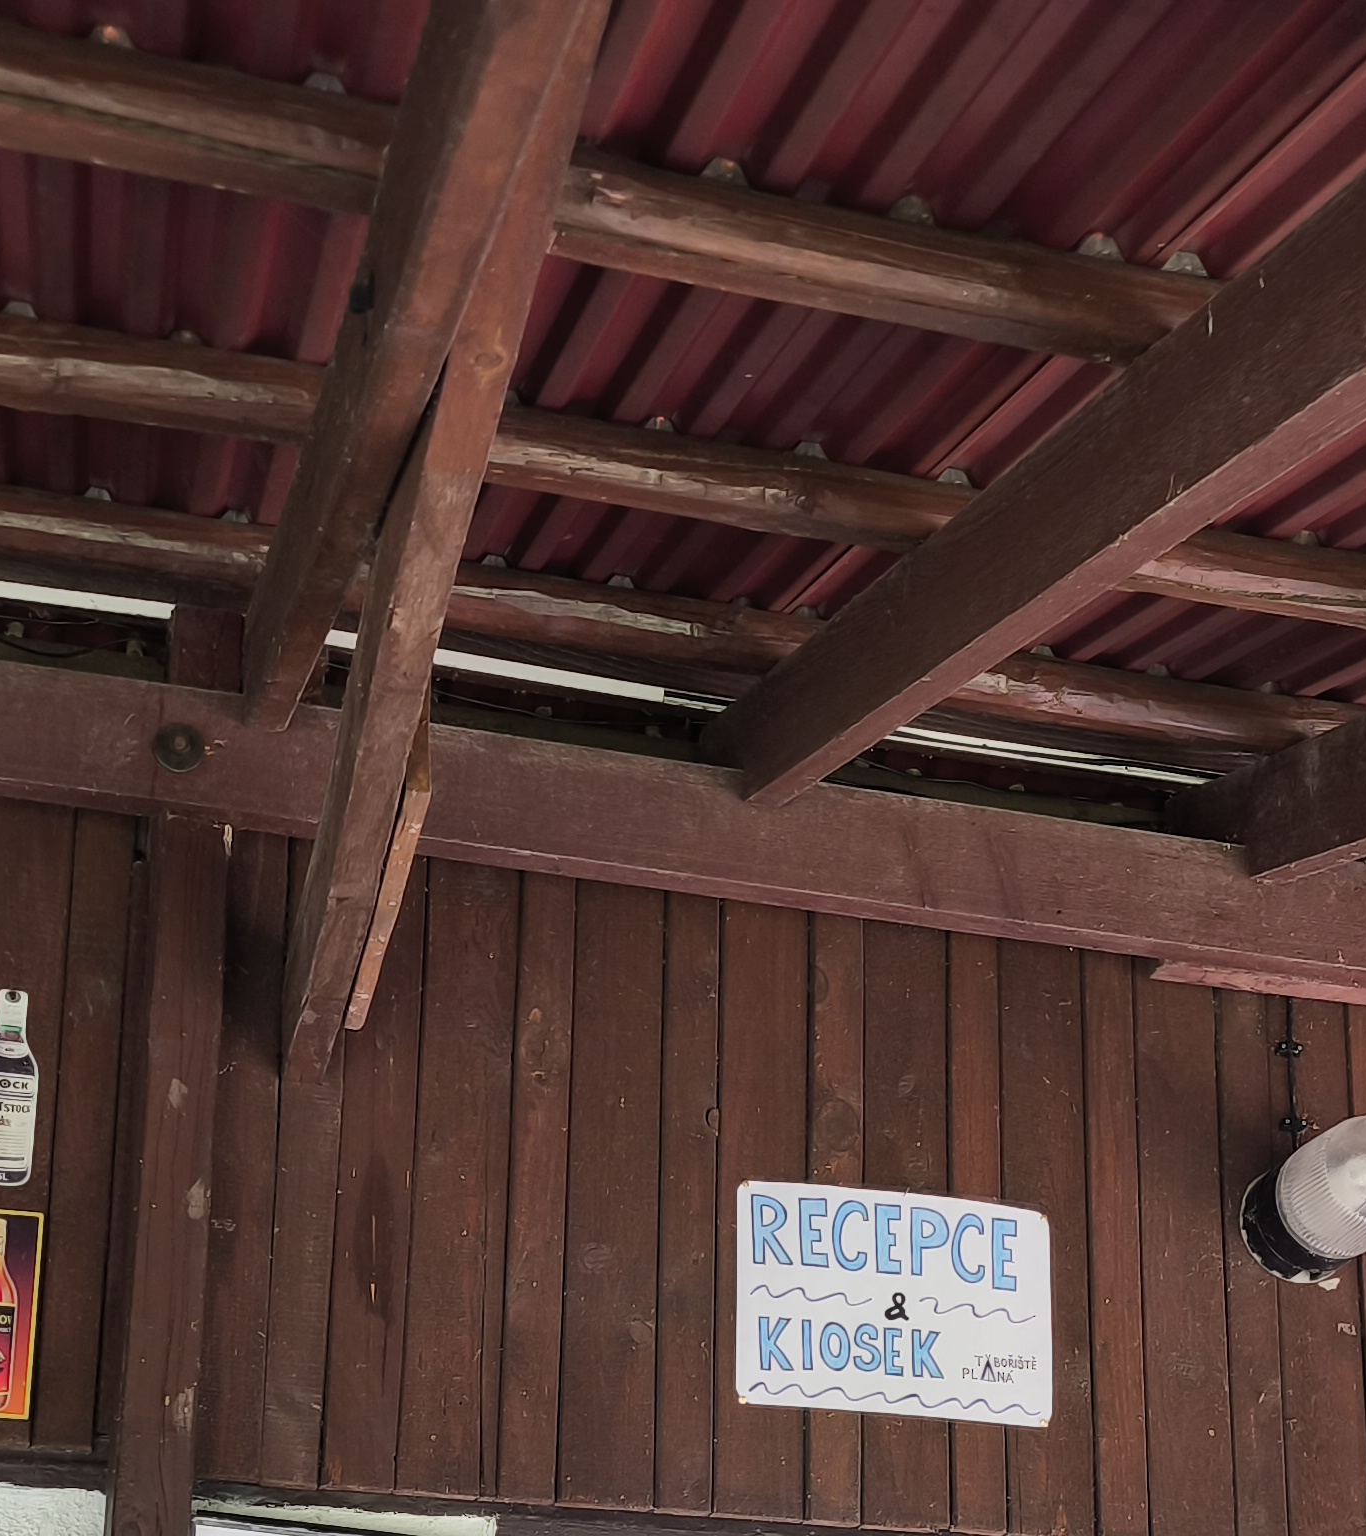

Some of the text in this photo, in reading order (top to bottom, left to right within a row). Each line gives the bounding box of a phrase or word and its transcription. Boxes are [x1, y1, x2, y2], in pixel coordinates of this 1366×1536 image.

[751, 1194, 1017, 1292] RECEPCE
[884, 1292, 910, 1321] &
[758, 1316, 944, 1379] KIOSEK
